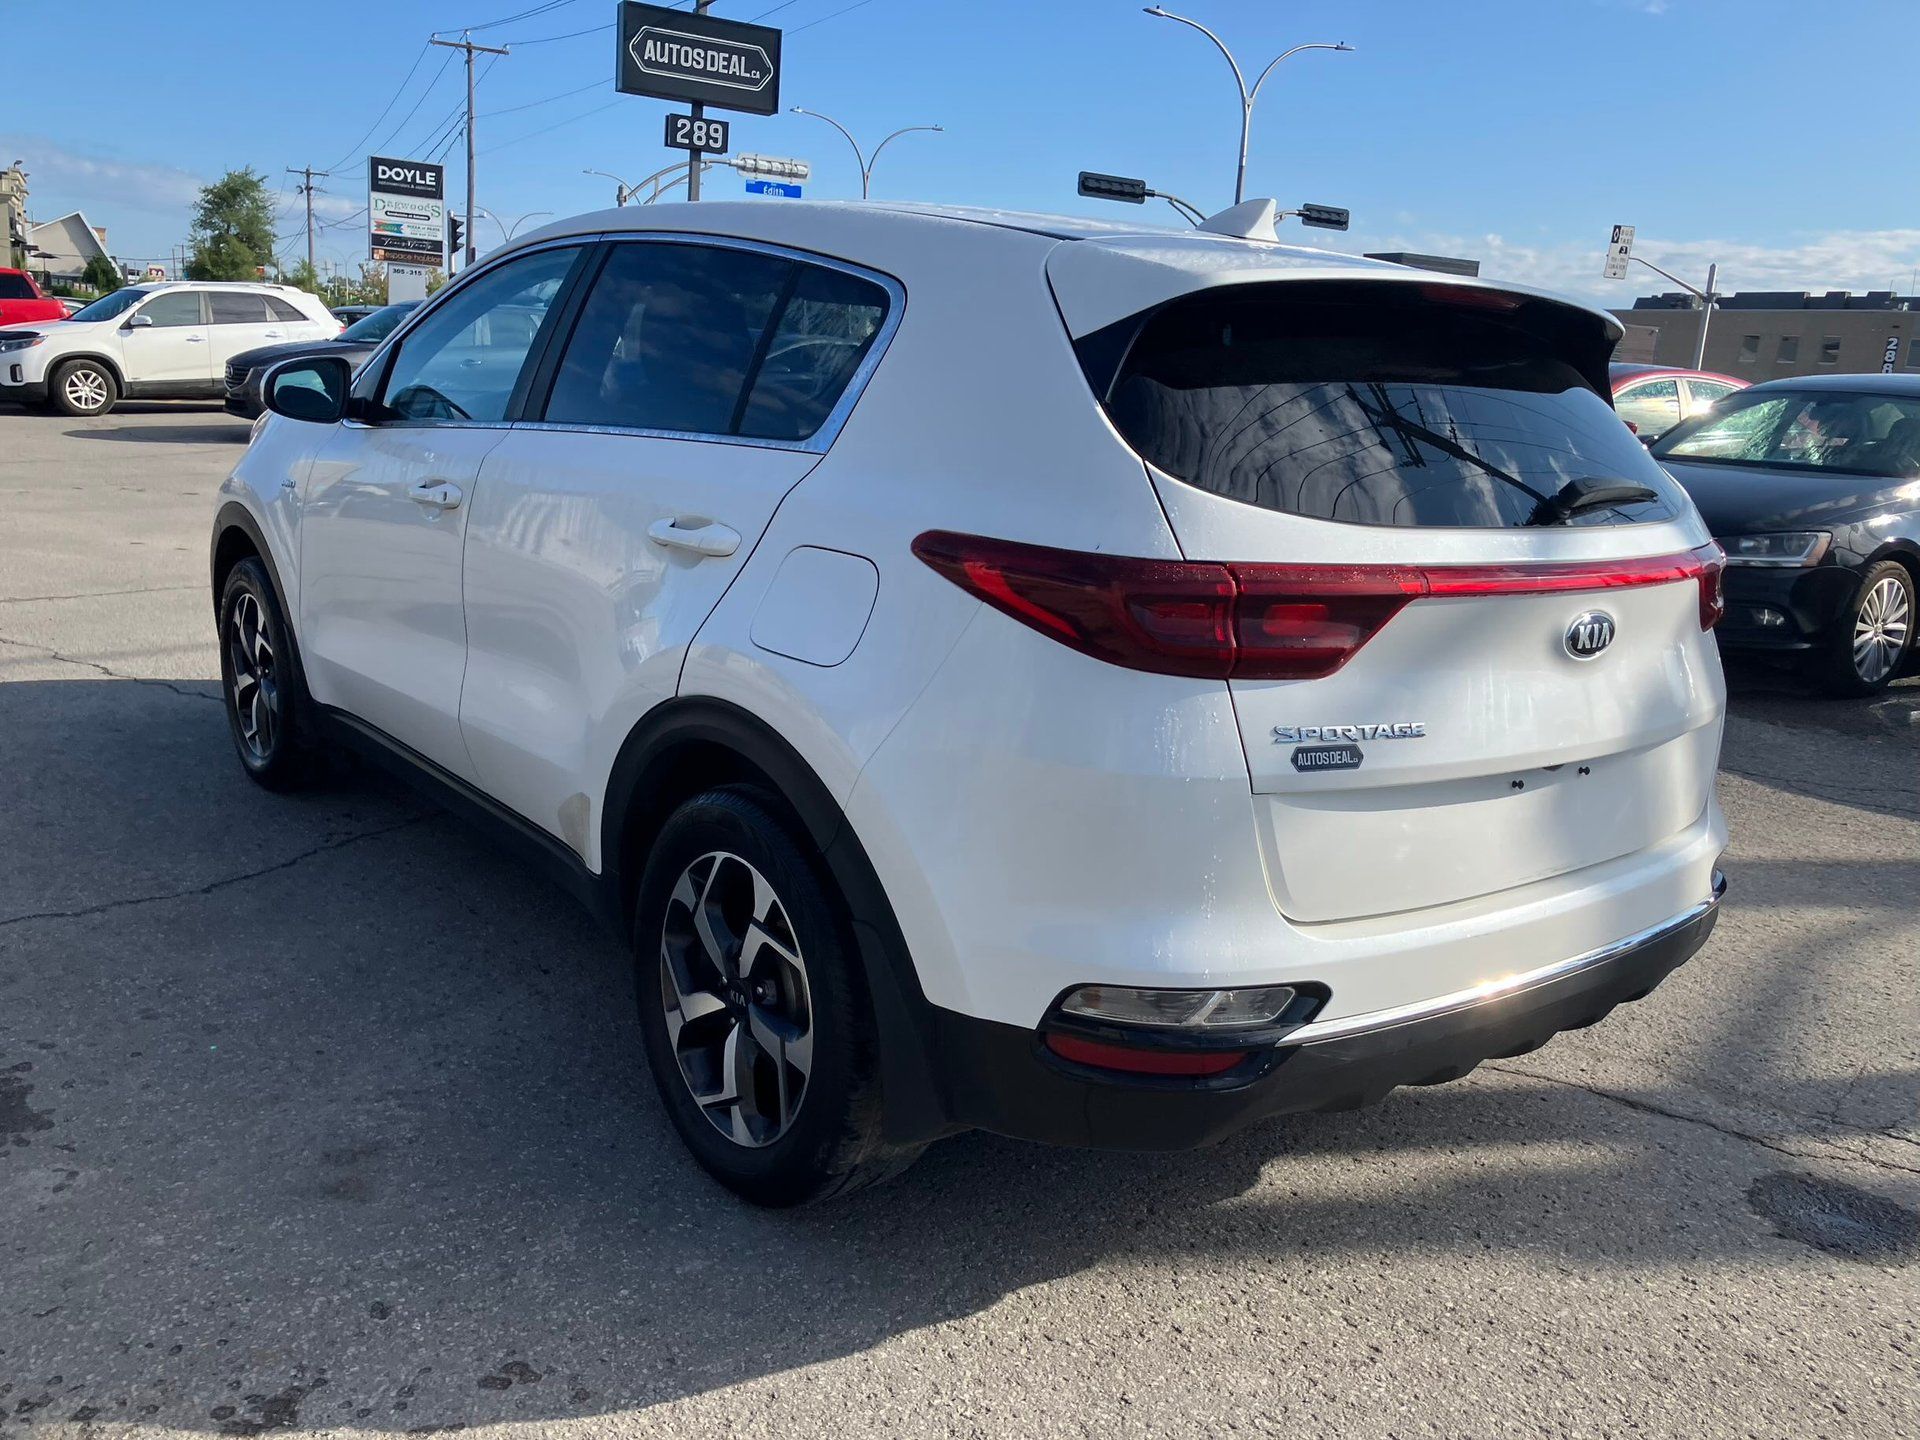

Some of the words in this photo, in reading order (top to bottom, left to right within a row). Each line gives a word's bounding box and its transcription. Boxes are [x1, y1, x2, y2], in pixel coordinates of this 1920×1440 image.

[676, 118, 723, 149] 289
[378, 165, 436, 186] DOYLE
[1577, 622, 1610, 650] KIA
[1274, 721, 1427, 744] SPORTAGE
